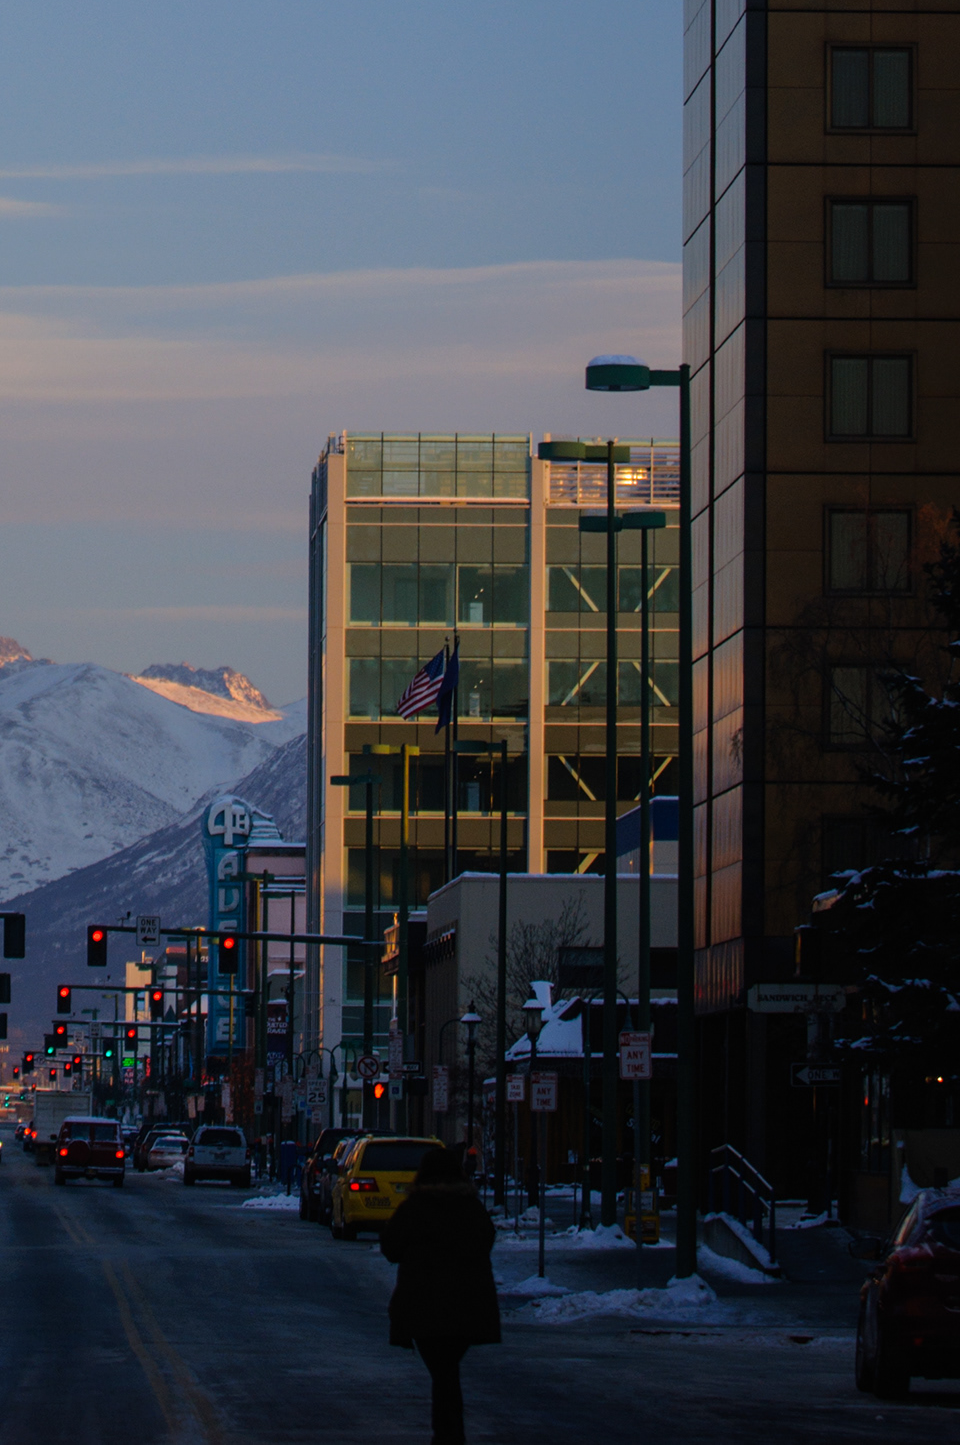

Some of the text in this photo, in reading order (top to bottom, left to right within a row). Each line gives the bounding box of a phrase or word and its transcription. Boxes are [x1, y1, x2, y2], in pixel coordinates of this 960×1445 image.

[140, 918, 157, 926] ONE
[140, 926, 157, 934] WAY
[758, 994, 808, 1002] SANDWICH
[626, 1051, 644, 1060] ANY
[626, 1064, 645, 1073] TIME
[807, 1071, 827, 1079] ONE
[536, 1087, 551, 1095] ANY
[308, 1092, 326, 1103] 25
[536, 1098, 552, 1106] TIME
